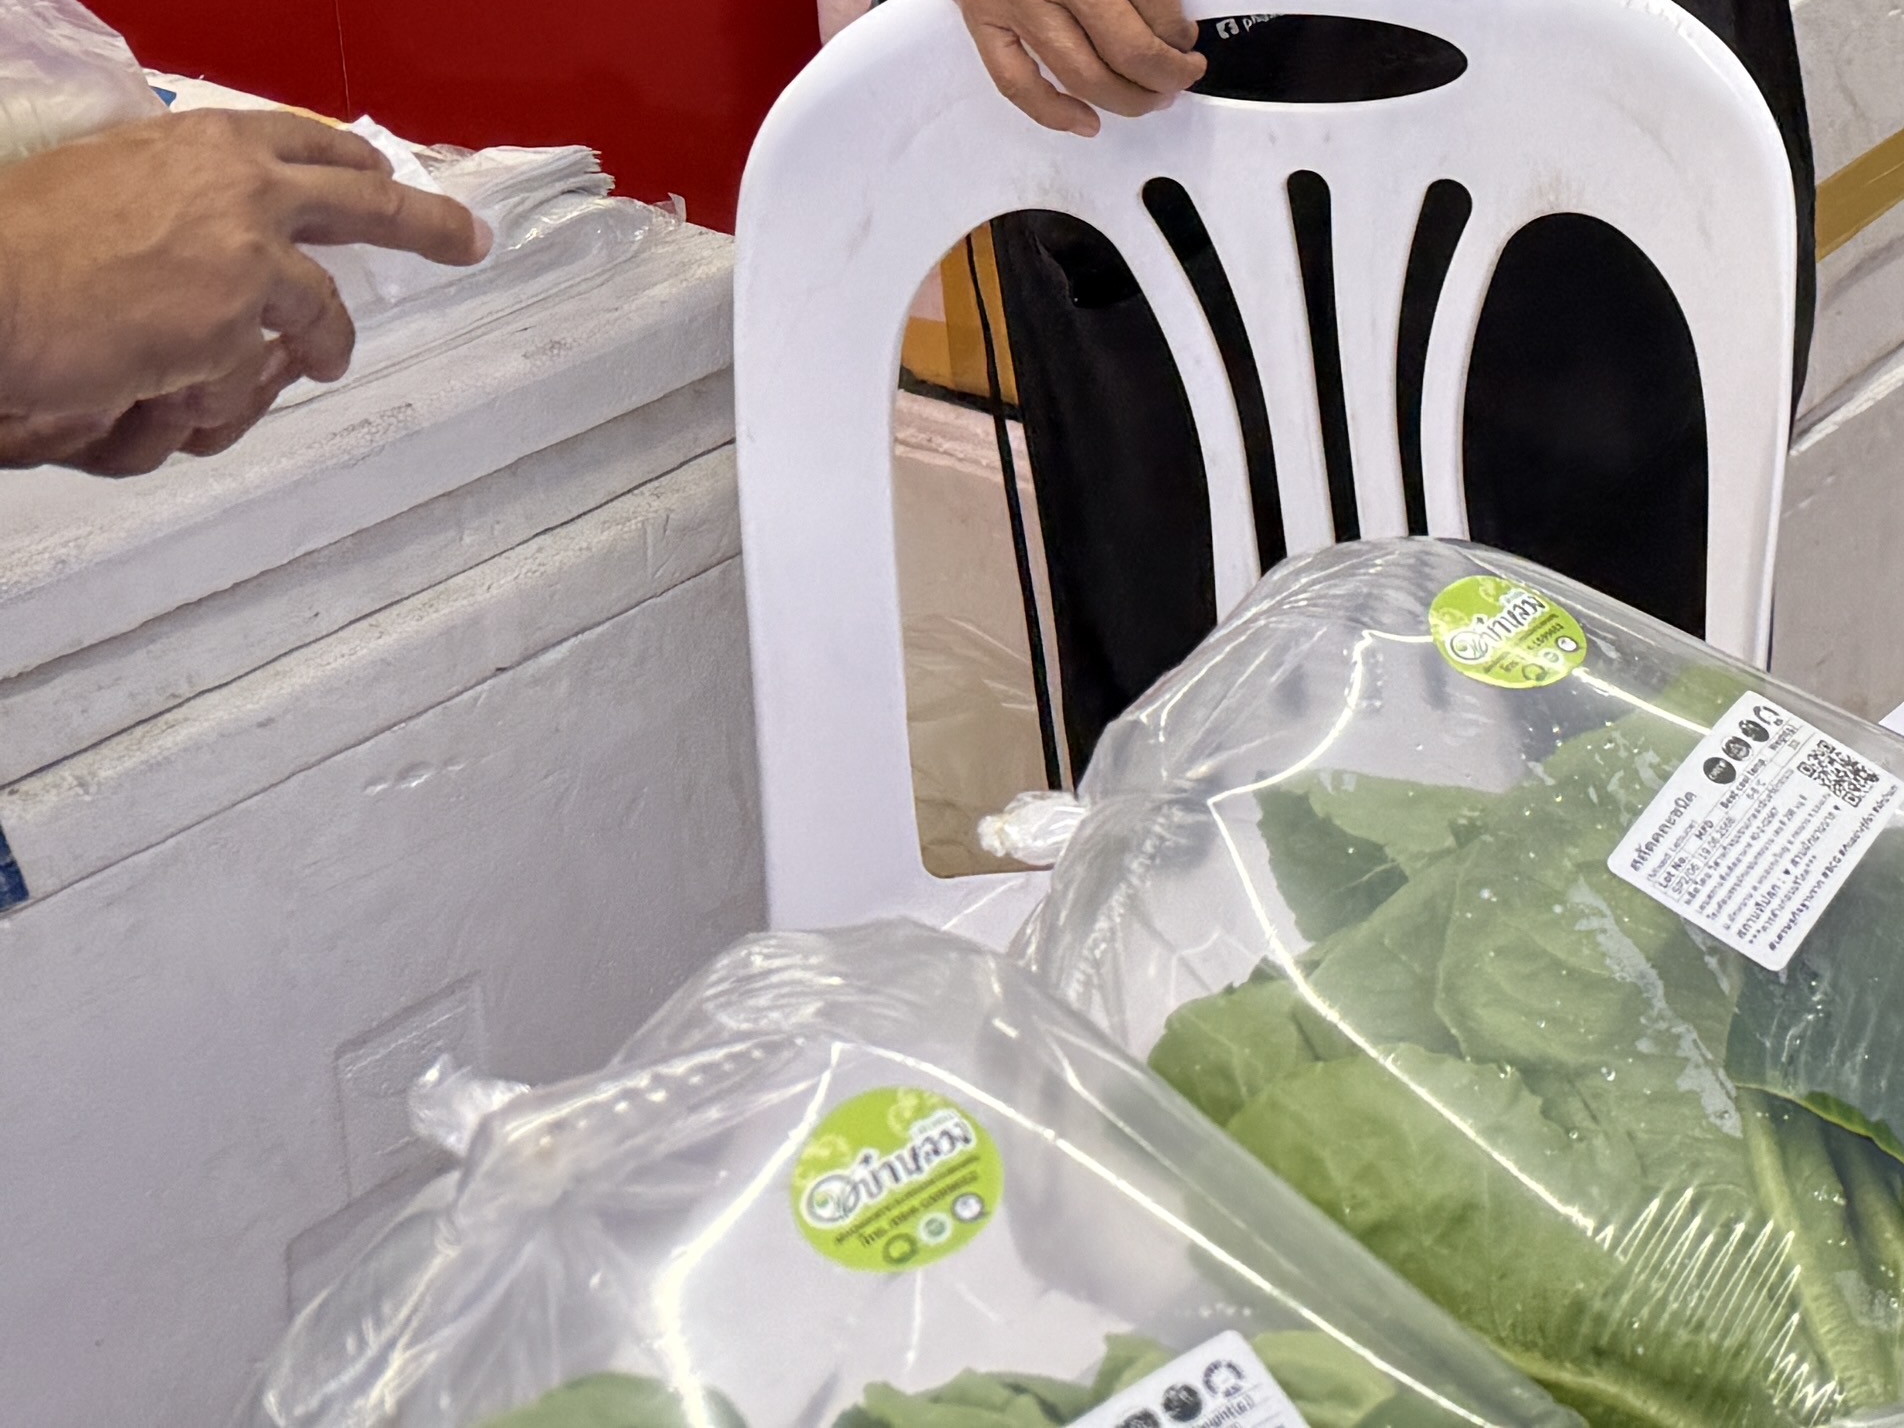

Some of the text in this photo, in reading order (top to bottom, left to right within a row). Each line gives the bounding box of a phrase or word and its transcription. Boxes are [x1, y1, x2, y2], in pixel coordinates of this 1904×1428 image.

[1658, 872, 1674, 887] Lot
[1672, 854, 1687, 870] No.
[1696, 820, 1714, 839] MFD
[1721, 792, 1737, 808] Best
